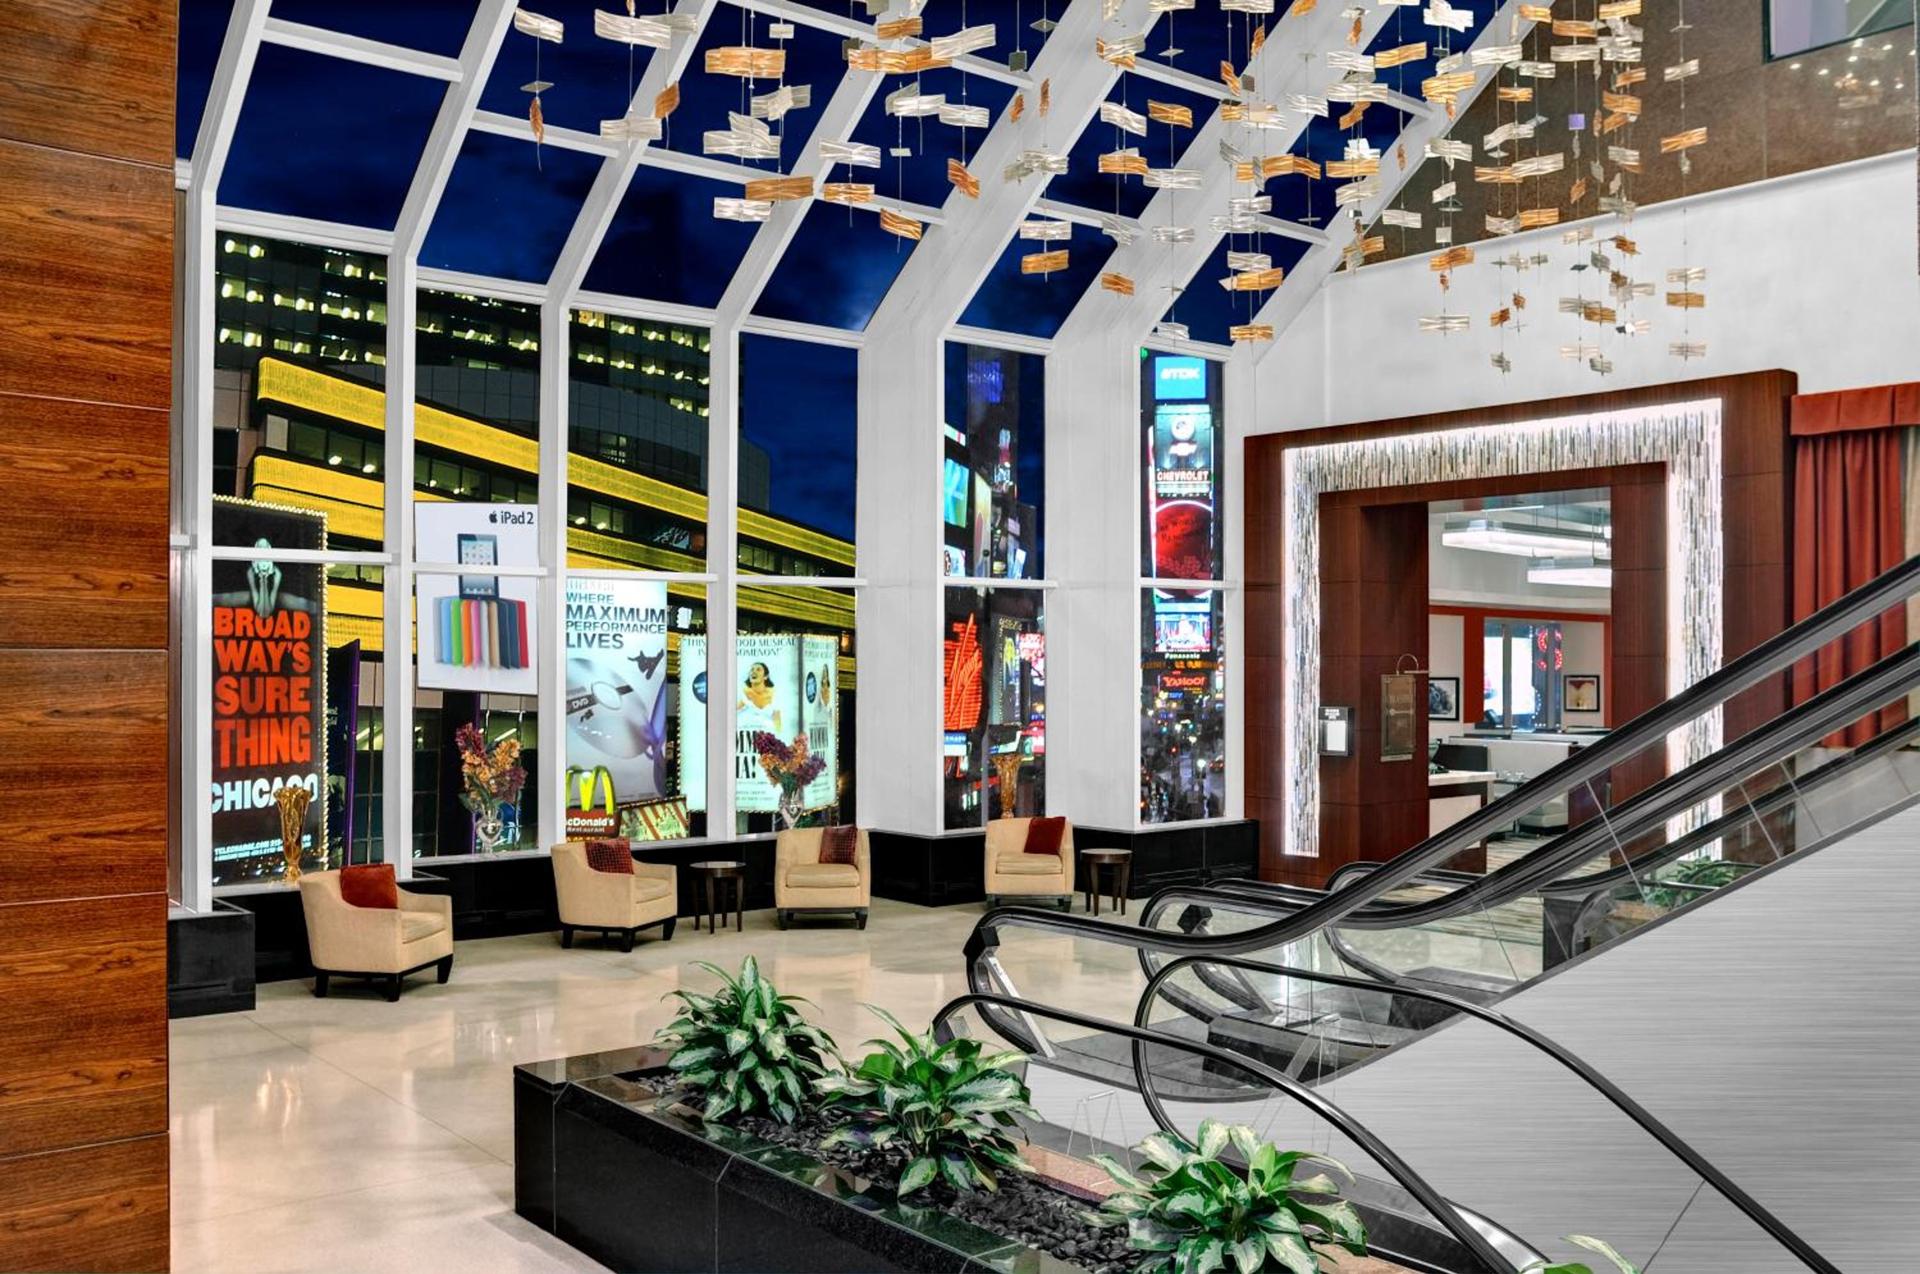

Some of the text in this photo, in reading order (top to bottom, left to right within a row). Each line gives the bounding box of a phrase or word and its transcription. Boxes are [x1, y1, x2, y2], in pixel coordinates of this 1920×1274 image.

[1156, 470, 1209, 481] CHEVROLET
[501, 510, 534, 524] iPad 2
[566, 592, 615, 605] WHERE
[566, 604, 665, 623] MAXIMUM
[213, 607, 311, 639] BROAD
[566, 620, 665, 634] PERFORMANCE
[566, 632, 624, 649] LIVES
[214, 639, 311, 673] WAY'S
[214, 675, 311, 716] SURE
[214, 715, 311, 768] THING
[567, 816, 615, 827] cDonald's
